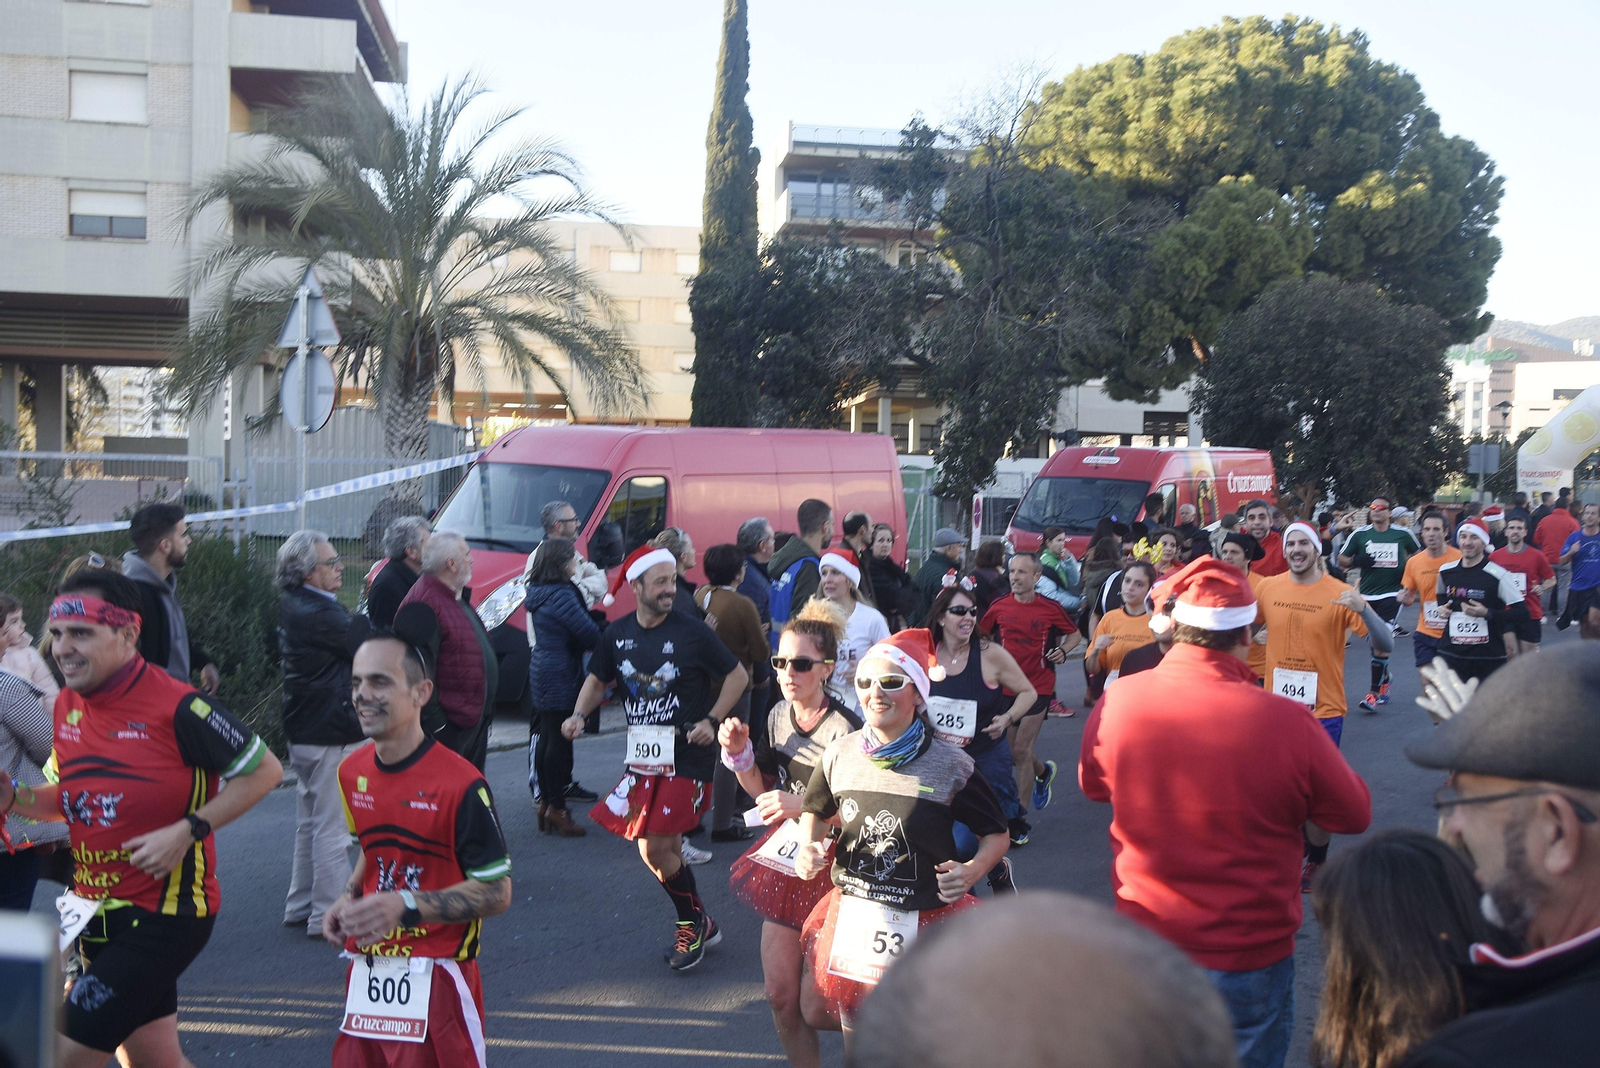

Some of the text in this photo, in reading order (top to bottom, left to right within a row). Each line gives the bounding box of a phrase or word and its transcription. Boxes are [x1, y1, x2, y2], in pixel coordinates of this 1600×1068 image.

[1227, 470, 1273, 495] Cruzcampo
[1457, 622, 1479, 633] 652
[1281, 683, 1305, 698] 494
[936, 712, 964, 730] 285
[634, 742, 661, 758] 590
[367, 976, 411, 1005] 600
[351, 1014, 412, 1036] Cruzcampo
